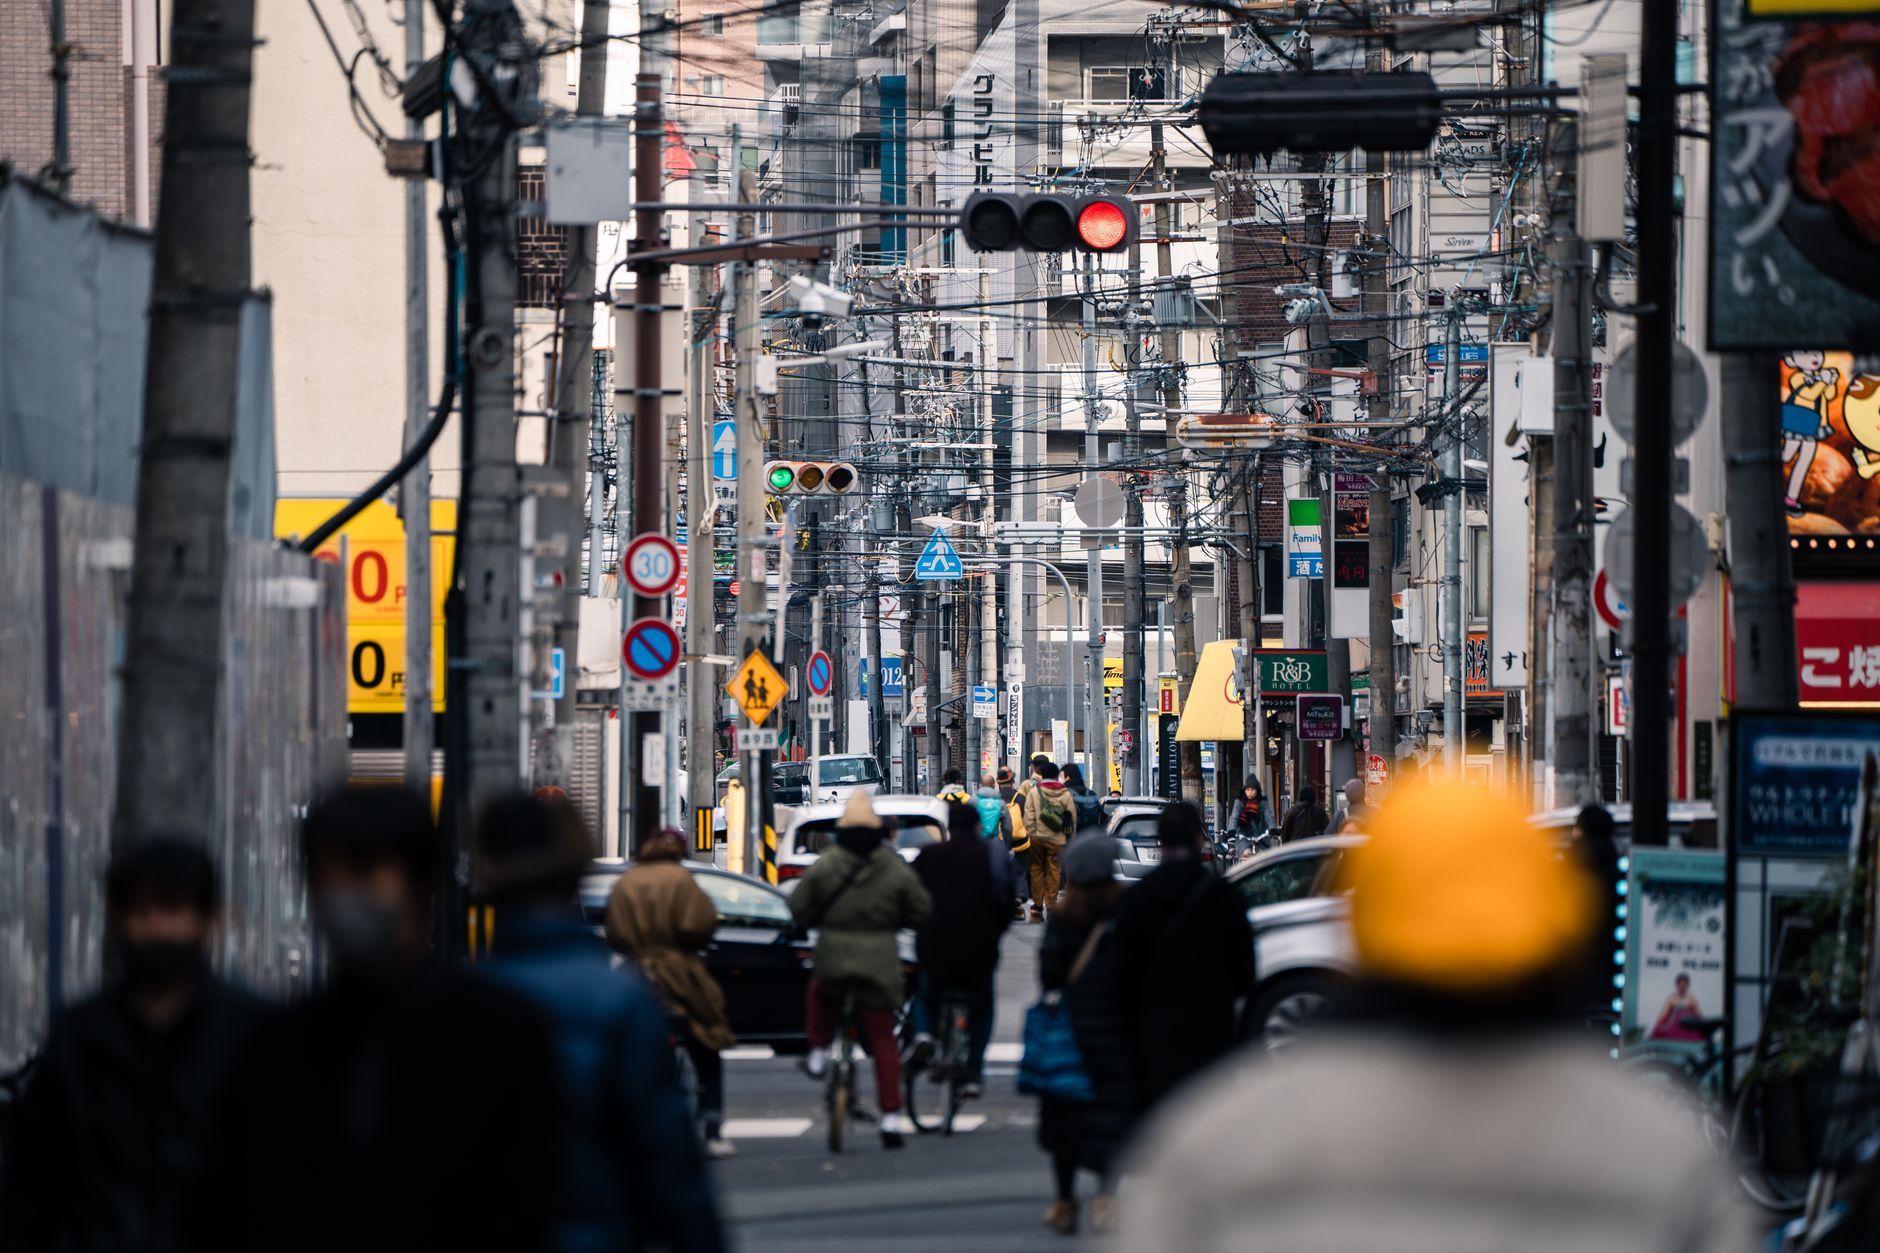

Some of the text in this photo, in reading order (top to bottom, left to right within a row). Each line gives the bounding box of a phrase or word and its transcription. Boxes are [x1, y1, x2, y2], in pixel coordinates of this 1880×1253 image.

[636, 552, 669, 578] 30
[1296, 560, 1310, 576] 酒
[1271, 661, 1312, 683] R&B
